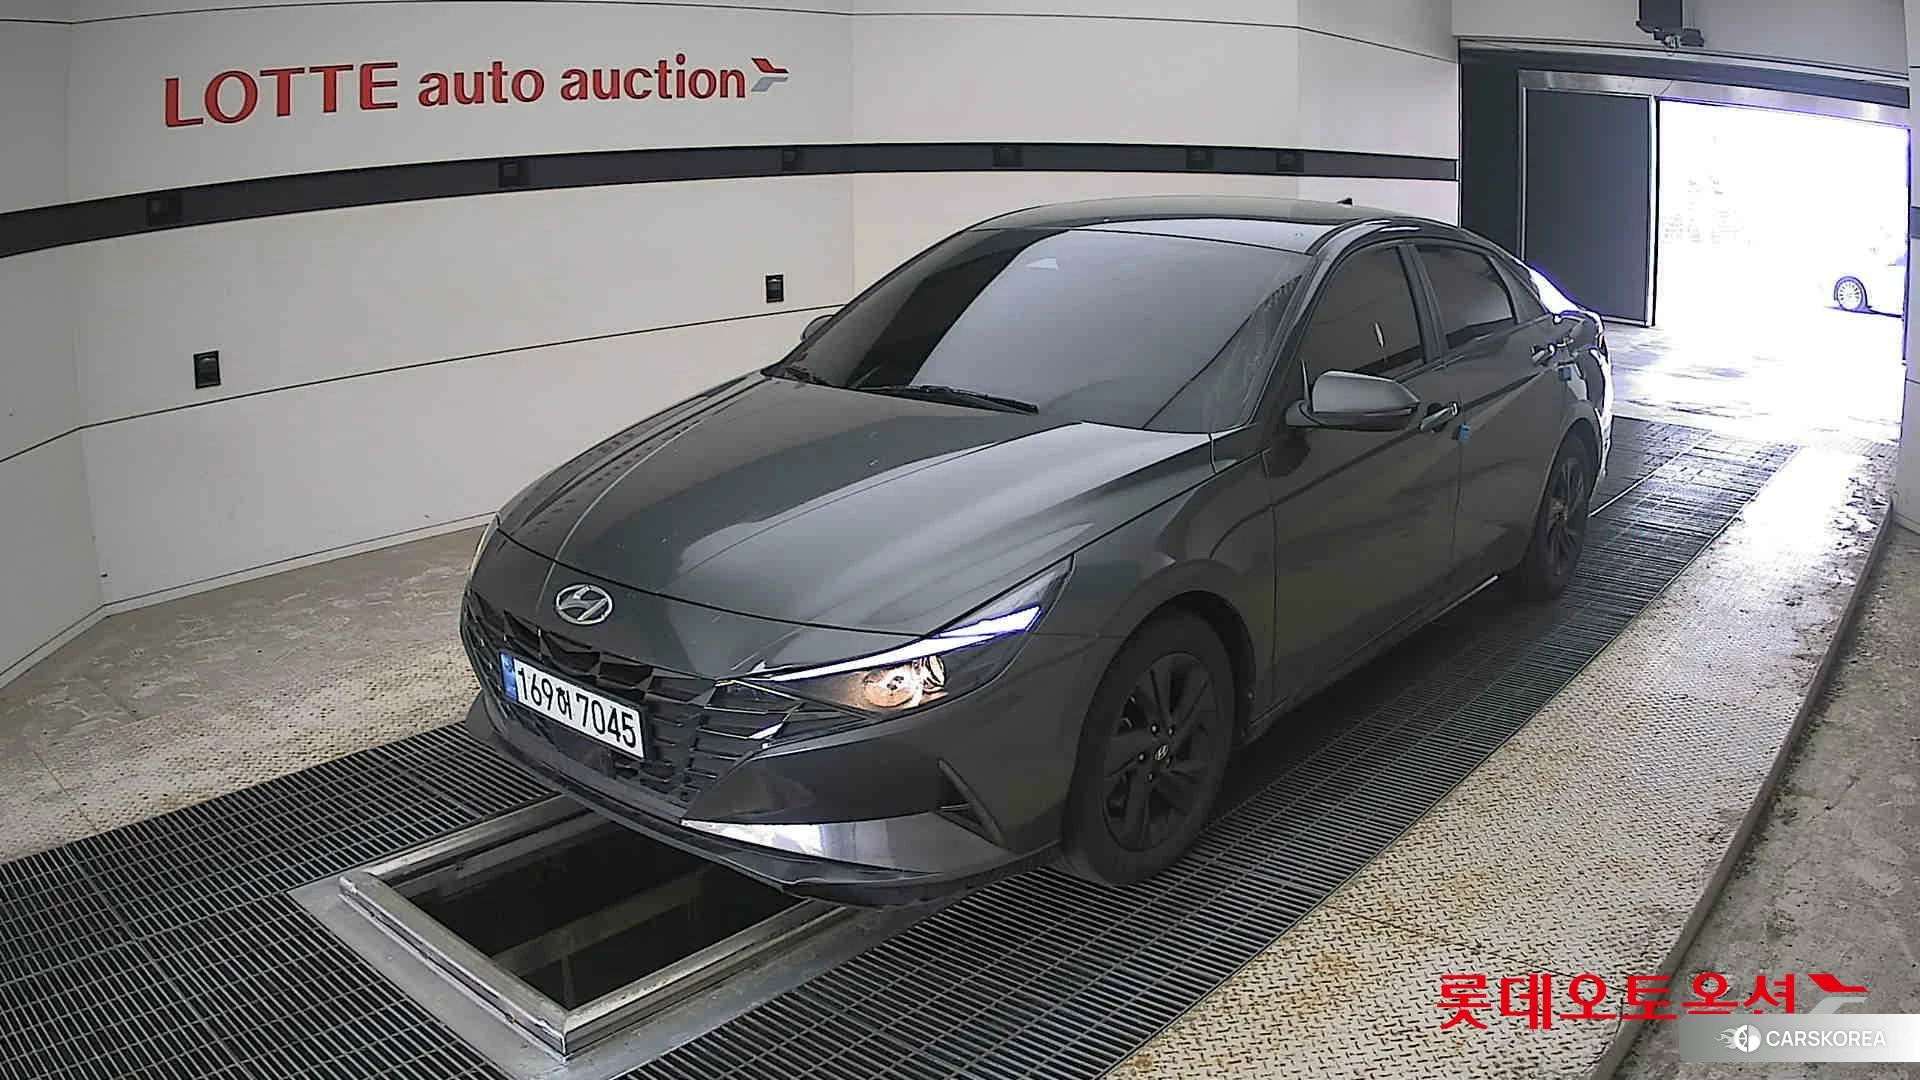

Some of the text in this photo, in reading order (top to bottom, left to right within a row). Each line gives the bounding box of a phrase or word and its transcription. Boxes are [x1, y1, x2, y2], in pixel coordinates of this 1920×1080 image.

[164, 53, 747, 127] LOTTE auto auction
[575, 692, 637, 749] 7045
